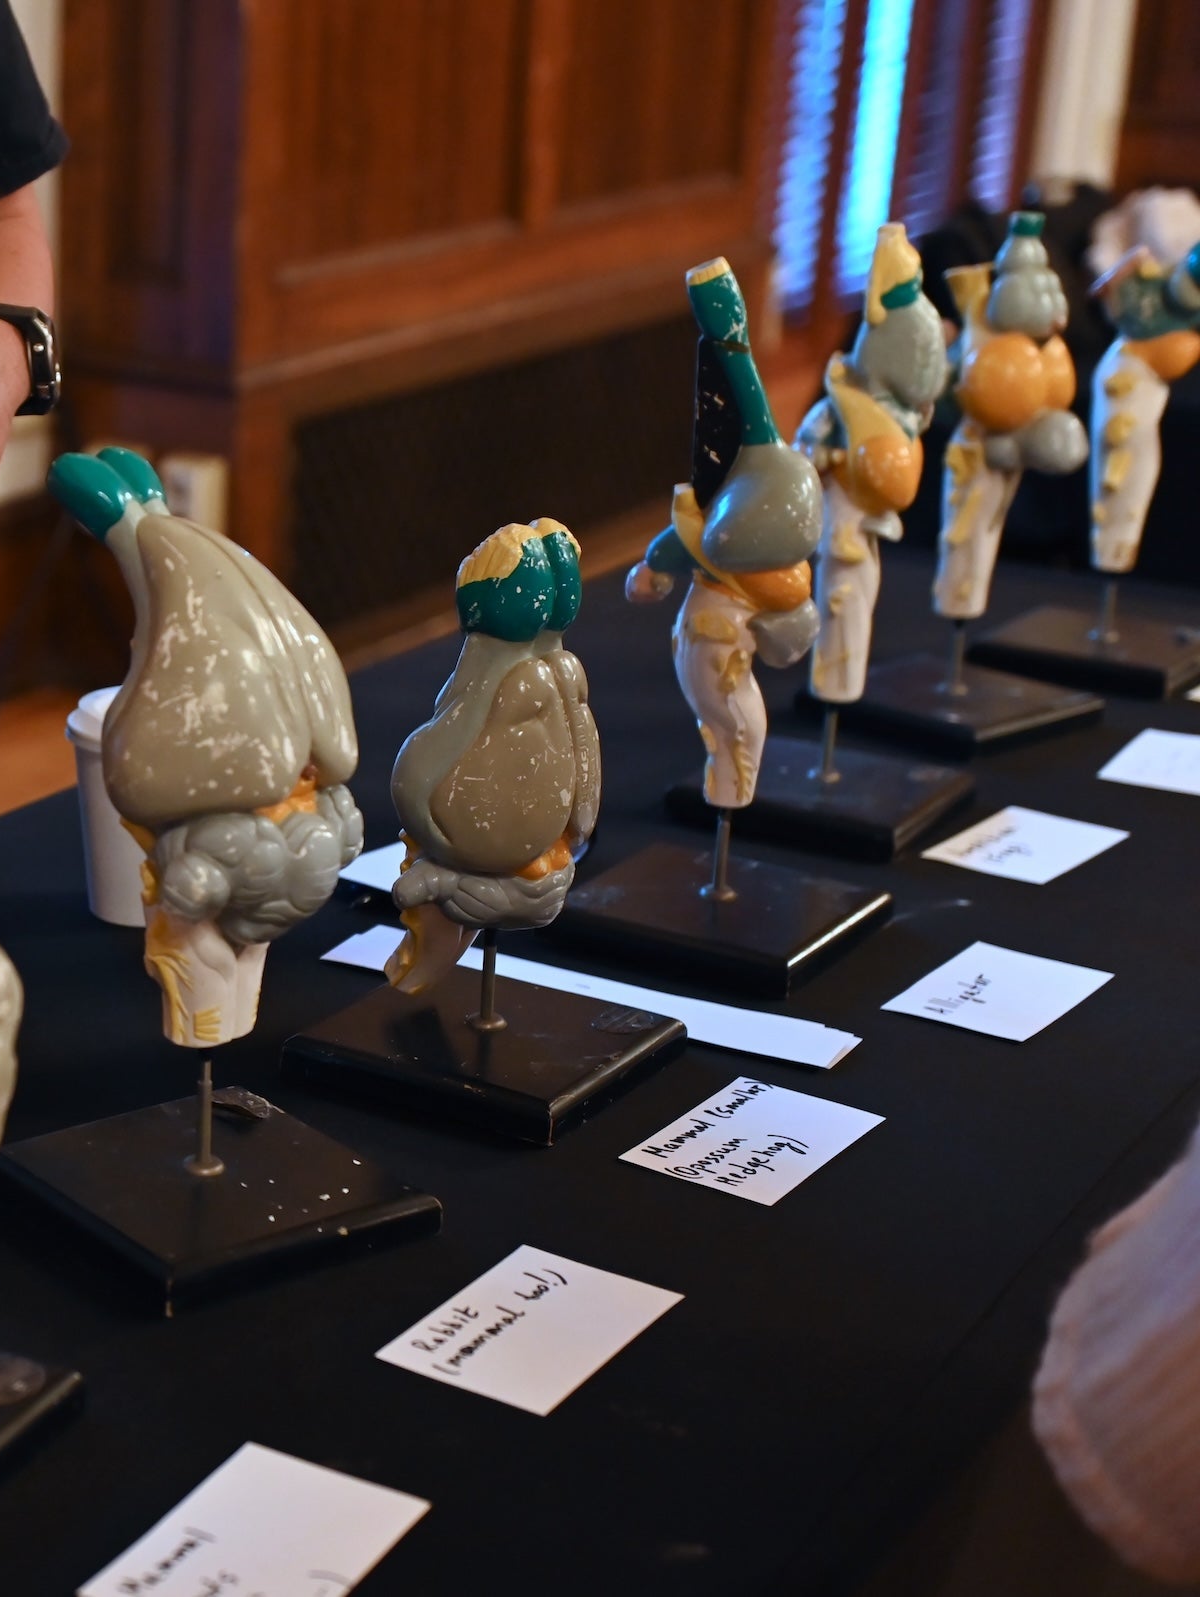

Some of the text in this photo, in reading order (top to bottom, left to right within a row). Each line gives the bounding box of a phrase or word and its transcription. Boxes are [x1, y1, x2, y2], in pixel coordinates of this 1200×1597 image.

[641, 1118, 717, 1159] Mammal
[664, 1137, 749, 1180] (Opossum
[714, 1134, 810, 1187] Hedgehog)
[411, 1306, 479, 1353] Rabbit
